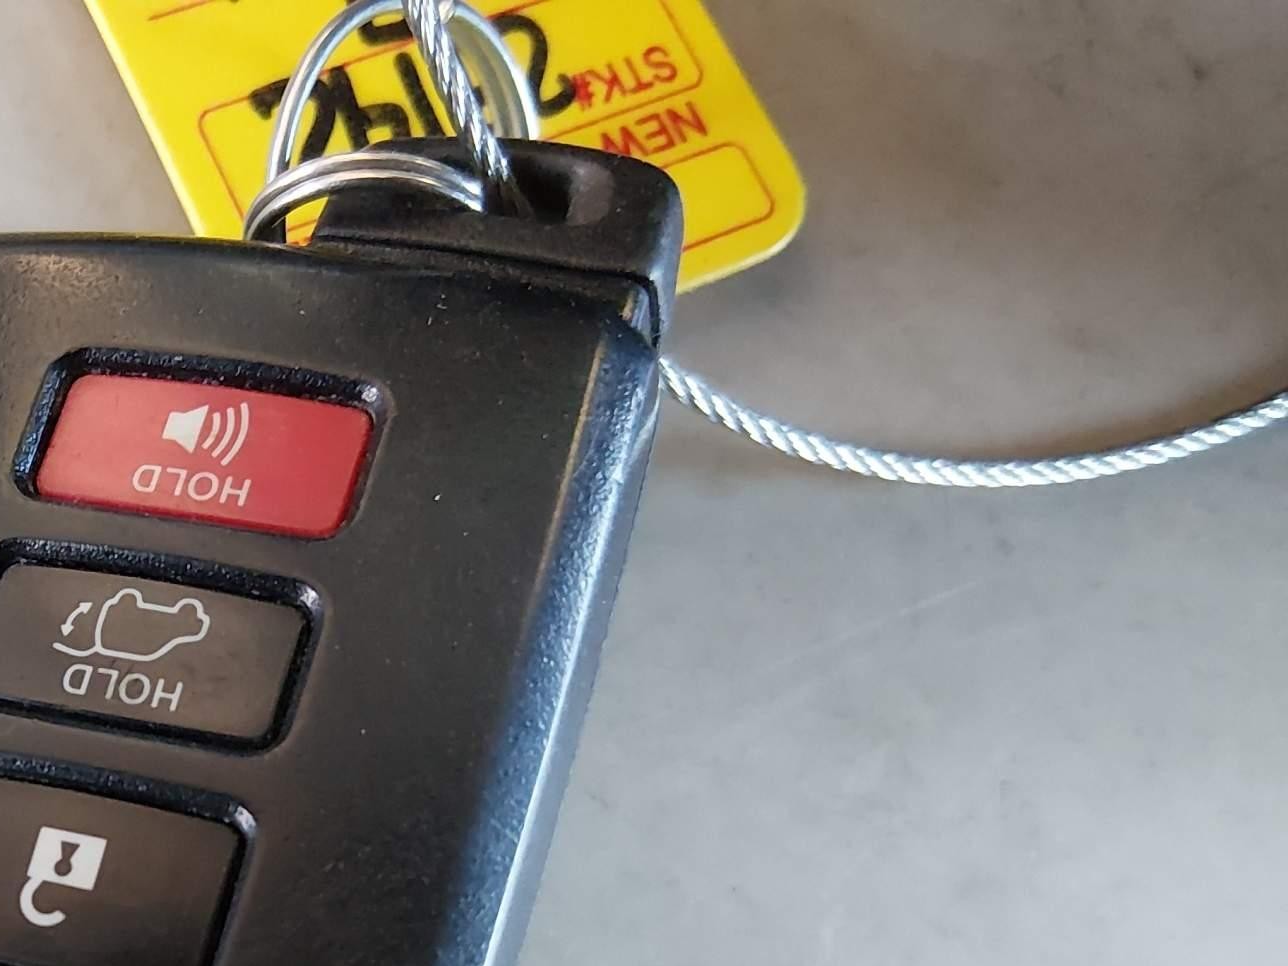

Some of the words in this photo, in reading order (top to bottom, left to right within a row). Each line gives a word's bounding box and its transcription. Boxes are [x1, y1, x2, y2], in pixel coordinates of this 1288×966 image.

[573, 46, 678, 112] STK#
[601, 101, 708, 157] NEW
[132, 464, 252, 507] HOLD
[62, 663, 184, 712] HOLD
